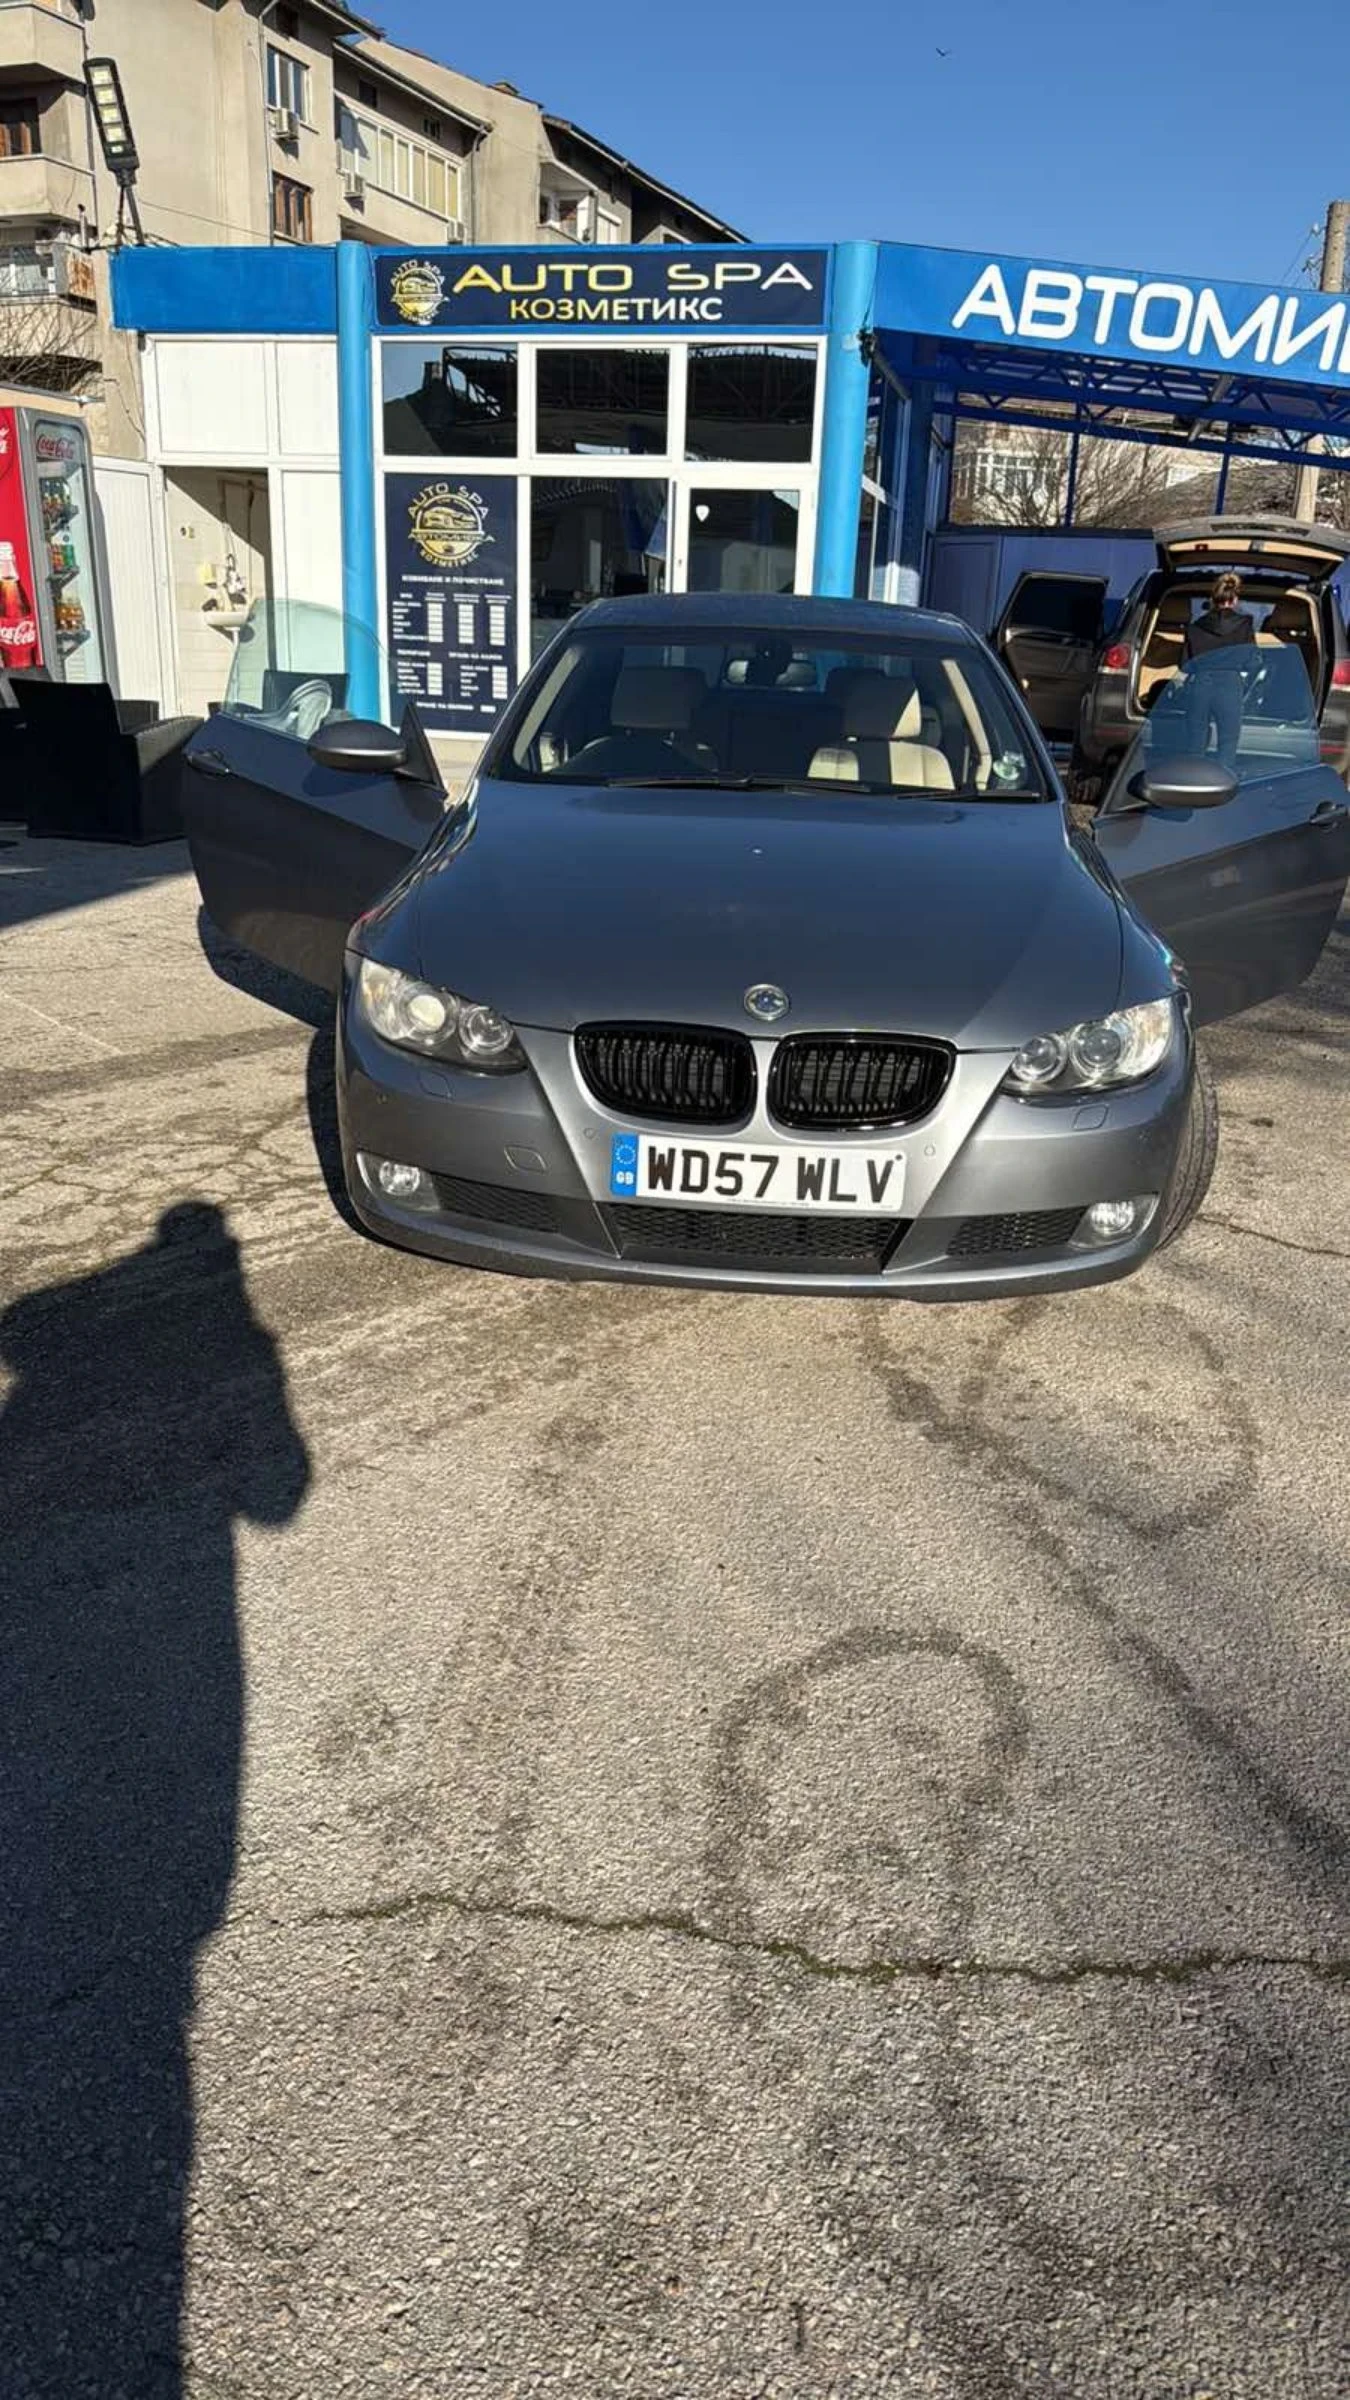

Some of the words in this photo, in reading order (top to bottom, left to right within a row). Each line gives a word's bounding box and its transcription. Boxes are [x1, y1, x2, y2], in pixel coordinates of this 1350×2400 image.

[452, 264, 632, 294] AUTO
[667, 262, 813, 291] SPA
[510, 297, 723, 321] КОЗМЕТИКС
[951, 263, 1350, 374] АВТОМИ
[407, 482, 449, 518] AUTO
[457, 485, 489, 519] SPA
[616, 1170, 634, 1185] GB
[648, 1146, 779, 1198] WD57
[797, 1157, 894, 1203] WLV
